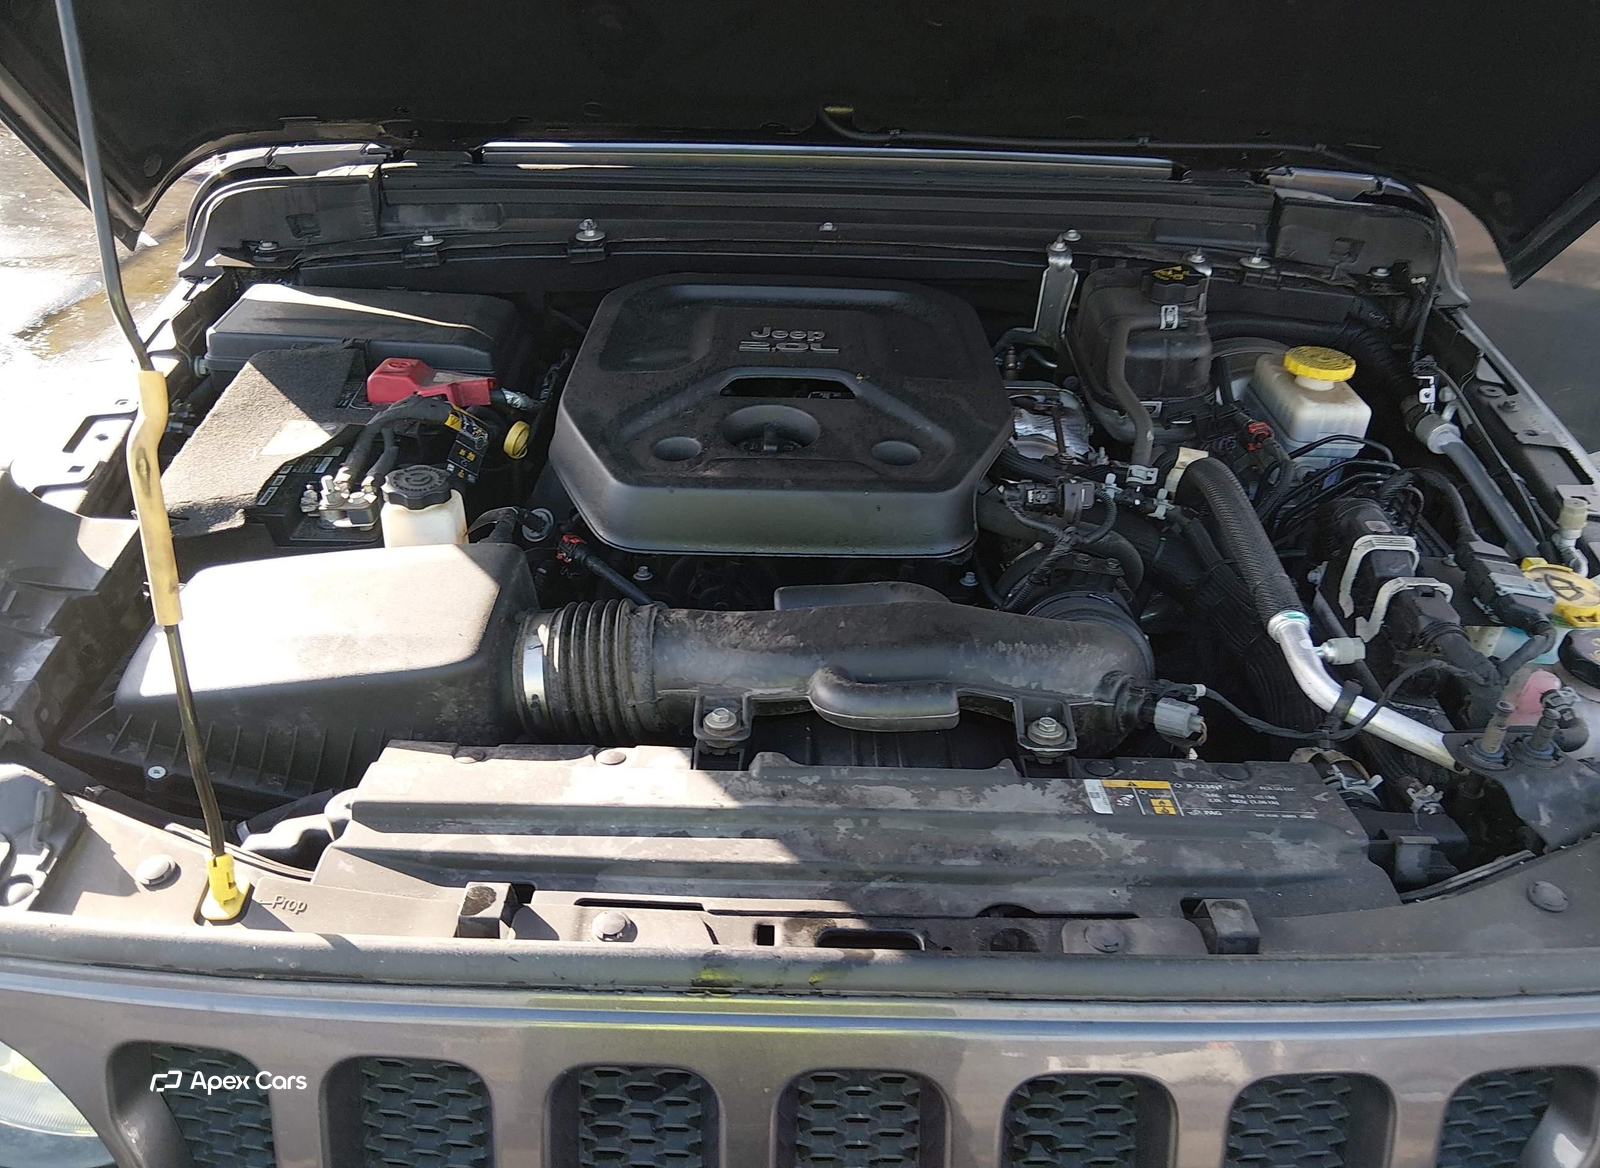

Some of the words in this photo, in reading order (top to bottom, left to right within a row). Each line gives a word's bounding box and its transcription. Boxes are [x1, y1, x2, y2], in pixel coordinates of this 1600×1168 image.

[750, 326, 826, 342] Jeep
[739, 341, 840, 354] 2.0L
[273, 895, 308, 916] Prop
